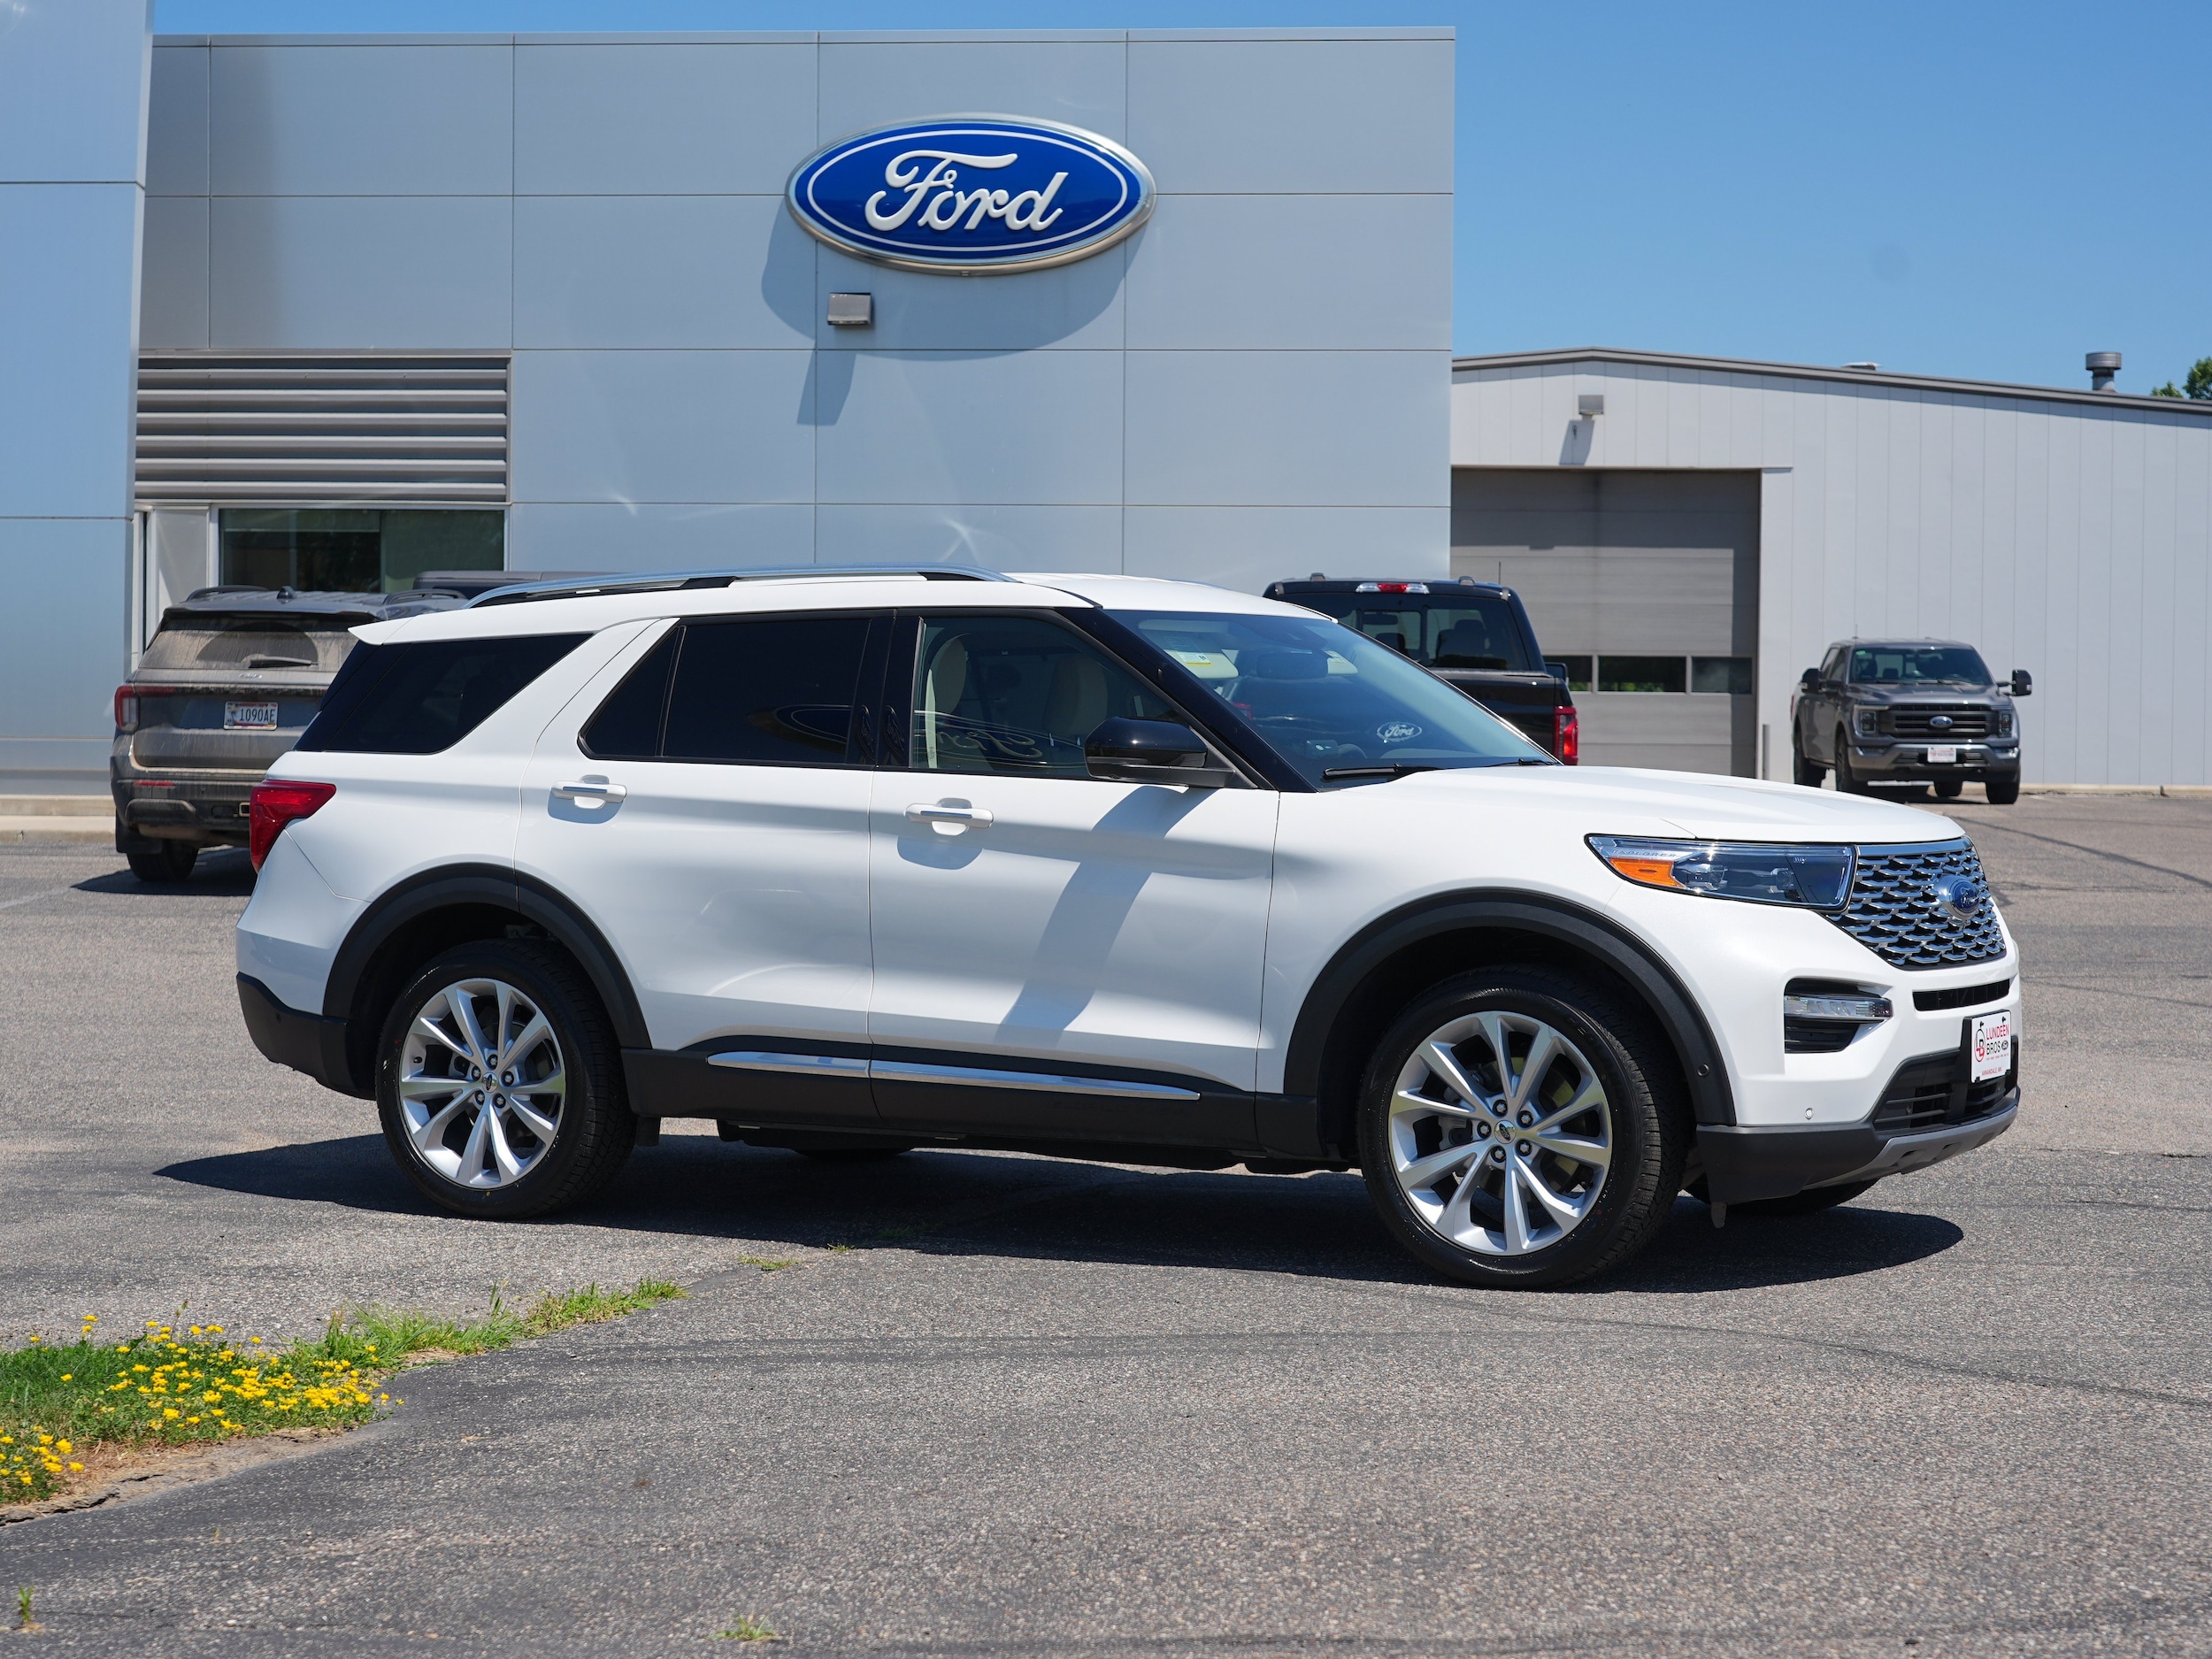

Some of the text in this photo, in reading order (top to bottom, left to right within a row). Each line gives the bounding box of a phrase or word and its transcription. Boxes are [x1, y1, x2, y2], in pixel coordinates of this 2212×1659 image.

[864, 150, 1069, 231] Ford
[1385, 724, 1414, 737] Ford
[1986, 1024, 2009, 1040] LUNDEEN
[1986, 1041, 2001, 1055] BROS
